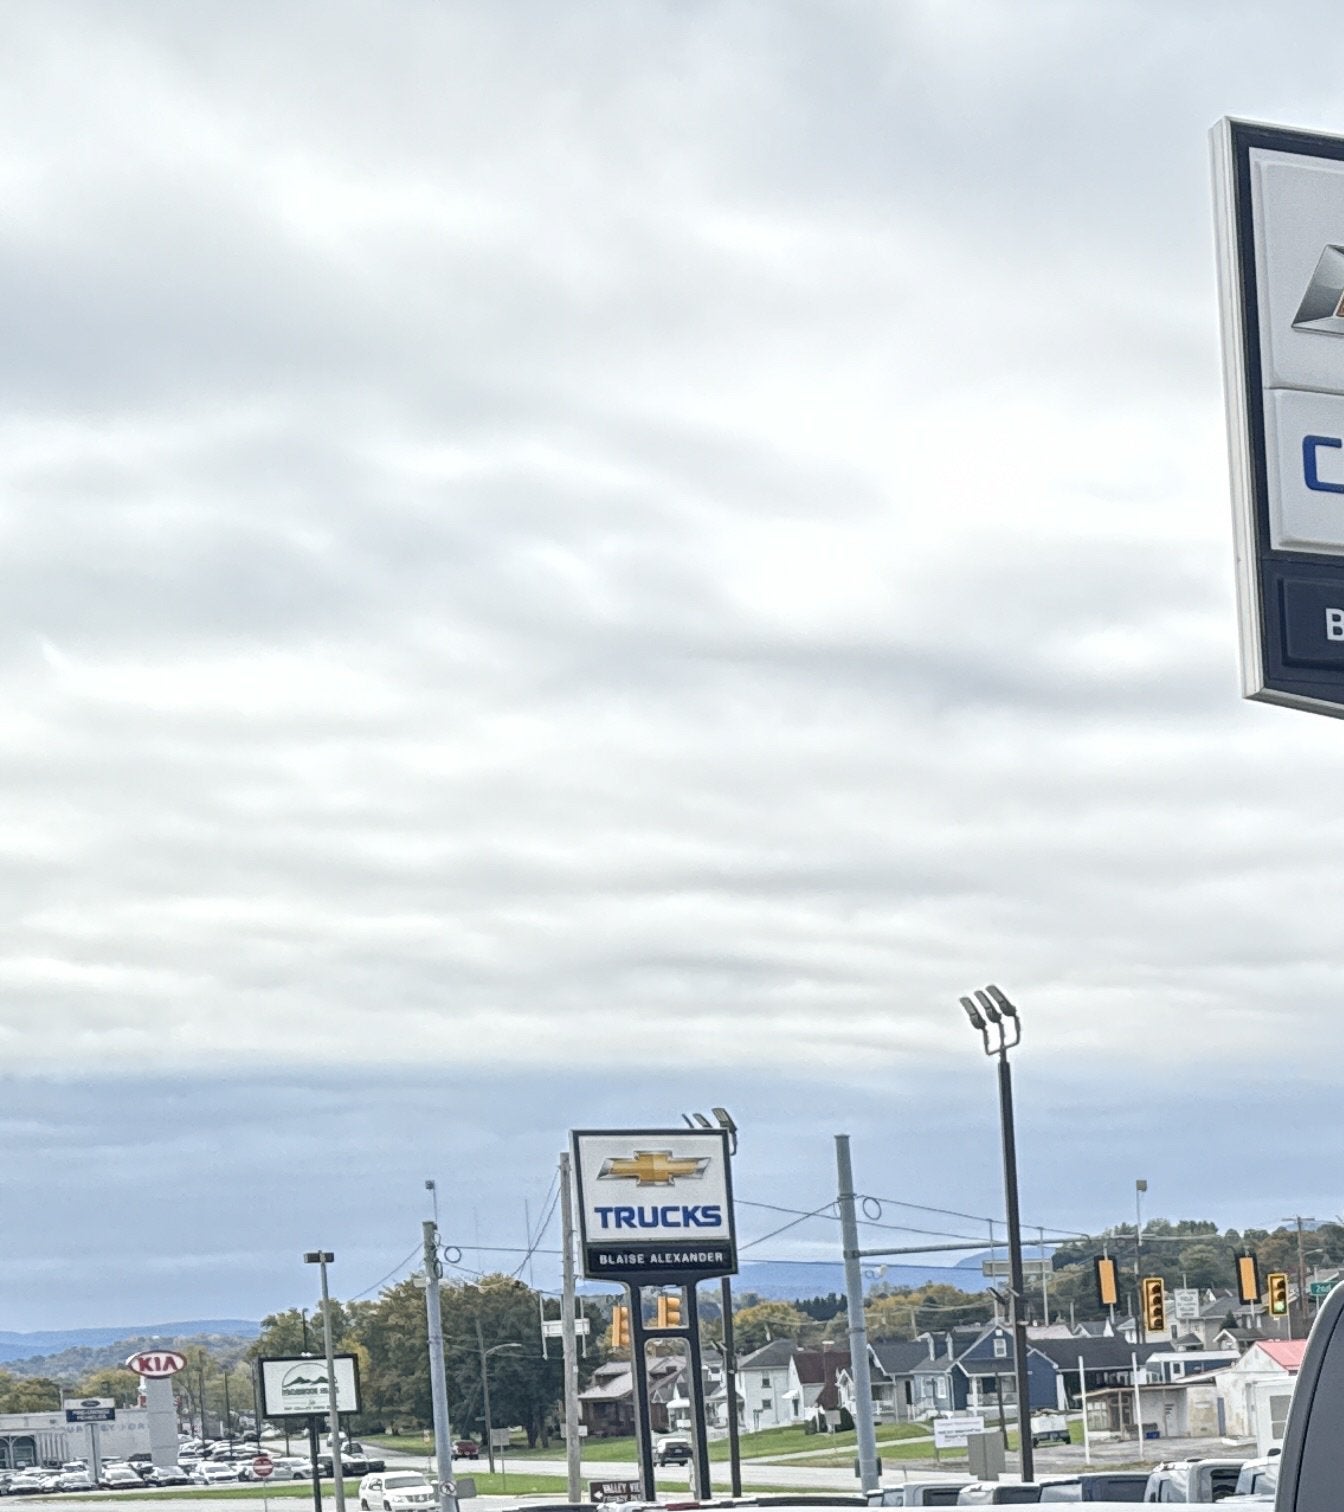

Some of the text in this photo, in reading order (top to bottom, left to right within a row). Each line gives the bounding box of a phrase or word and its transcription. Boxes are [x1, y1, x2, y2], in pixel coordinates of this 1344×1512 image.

[594, 1205, 722, 1229] TRUCKS
[600, 1252, 723, 1265] BLAISE ALEXANDER
[138, 1356, 178, 1371] KIA
